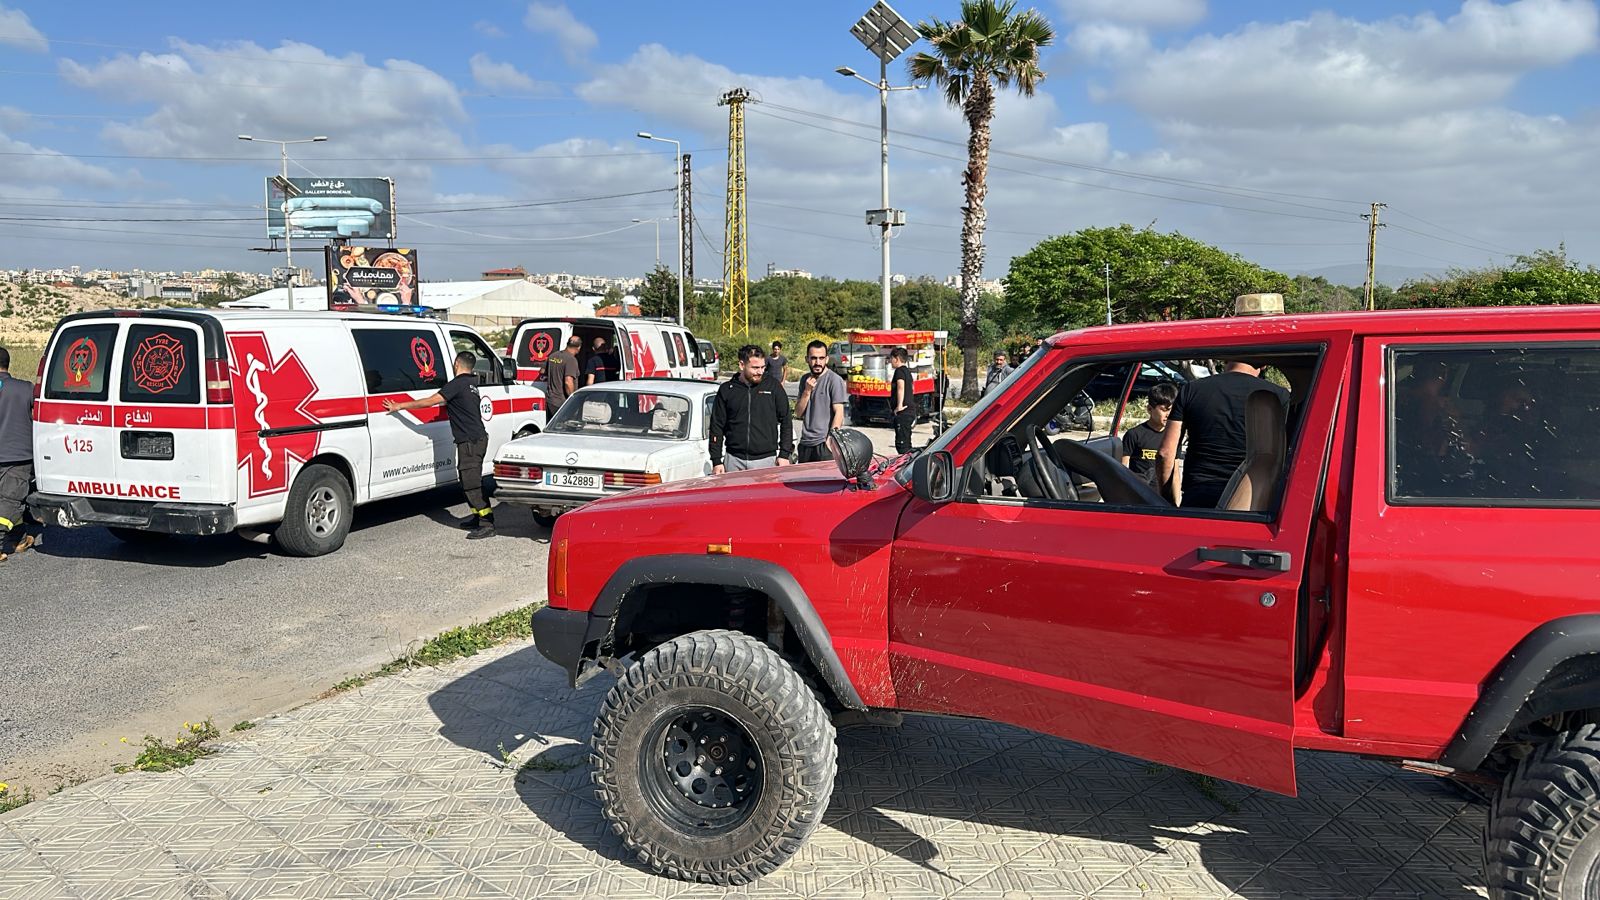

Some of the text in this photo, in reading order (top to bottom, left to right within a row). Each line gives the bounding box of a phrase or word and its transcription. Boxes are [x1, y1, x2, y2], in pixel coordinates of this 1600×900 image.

[481, 403, 492, 414] 125
[76, 409, 153, 428] الدفاع المدني
[73, 439, 93, 453] 125
[1141, 449, 1158, 460] Fer
[562, 475, 594, 487] 342889
[67, 481, 181, 500] AMBULANCE
